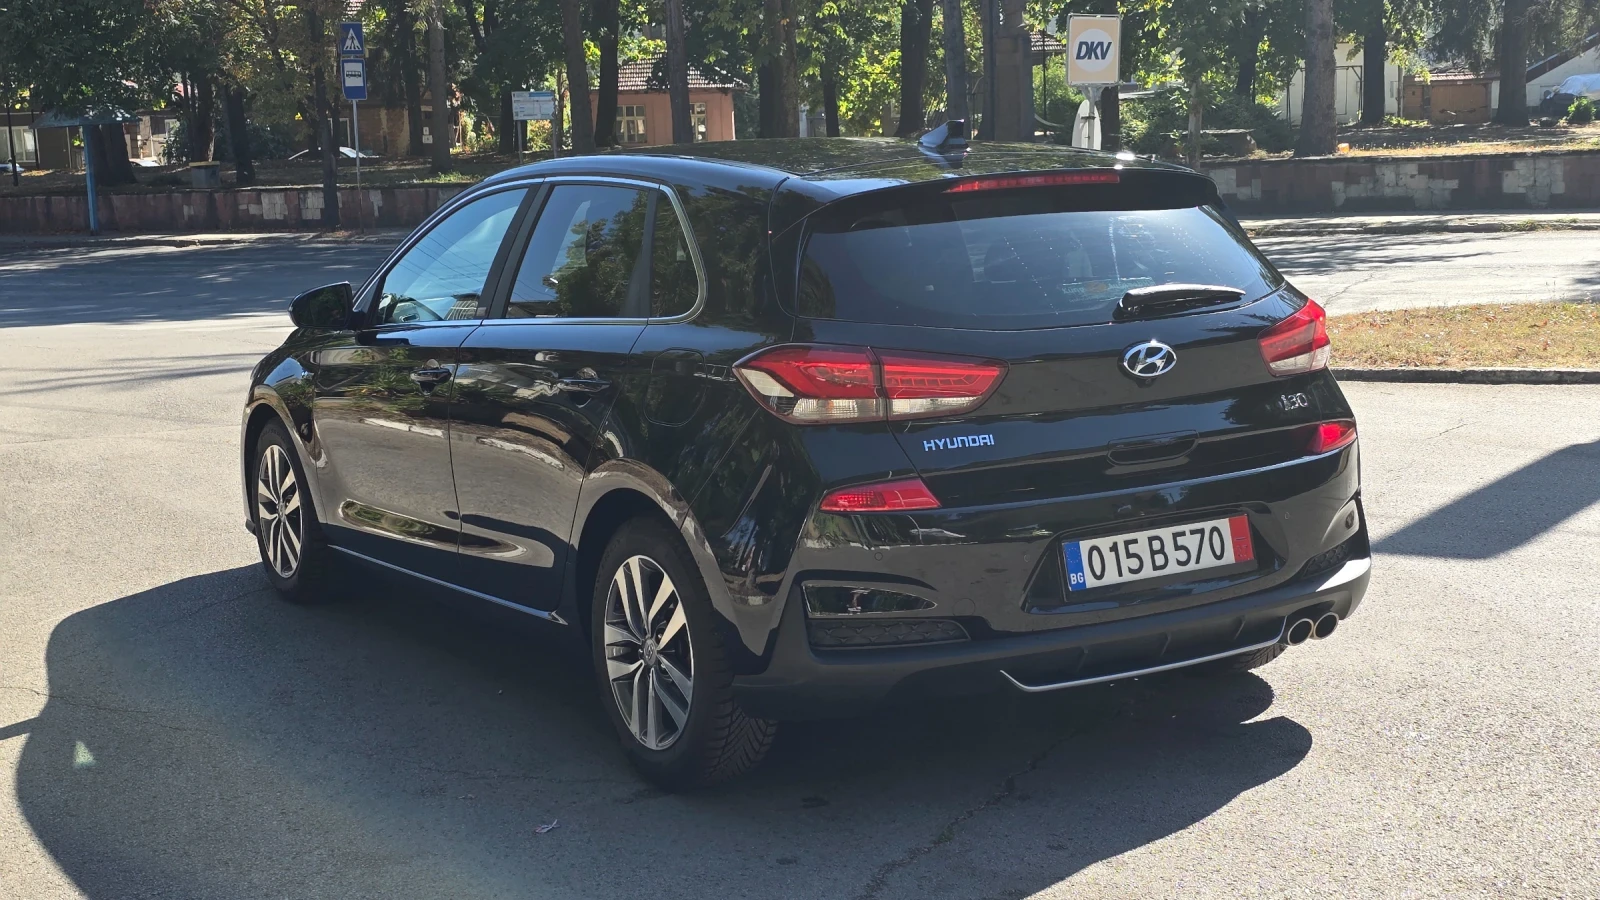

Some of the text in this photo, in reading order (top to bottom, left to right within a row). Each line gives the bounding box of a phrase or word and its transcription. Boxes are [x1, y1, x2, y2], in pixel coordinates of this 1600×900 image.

[1075, 41, 1112, 60] DKV
[923, 434, 995, 452] HYUNDAI
[1070, 572, 1084, 585] BG
